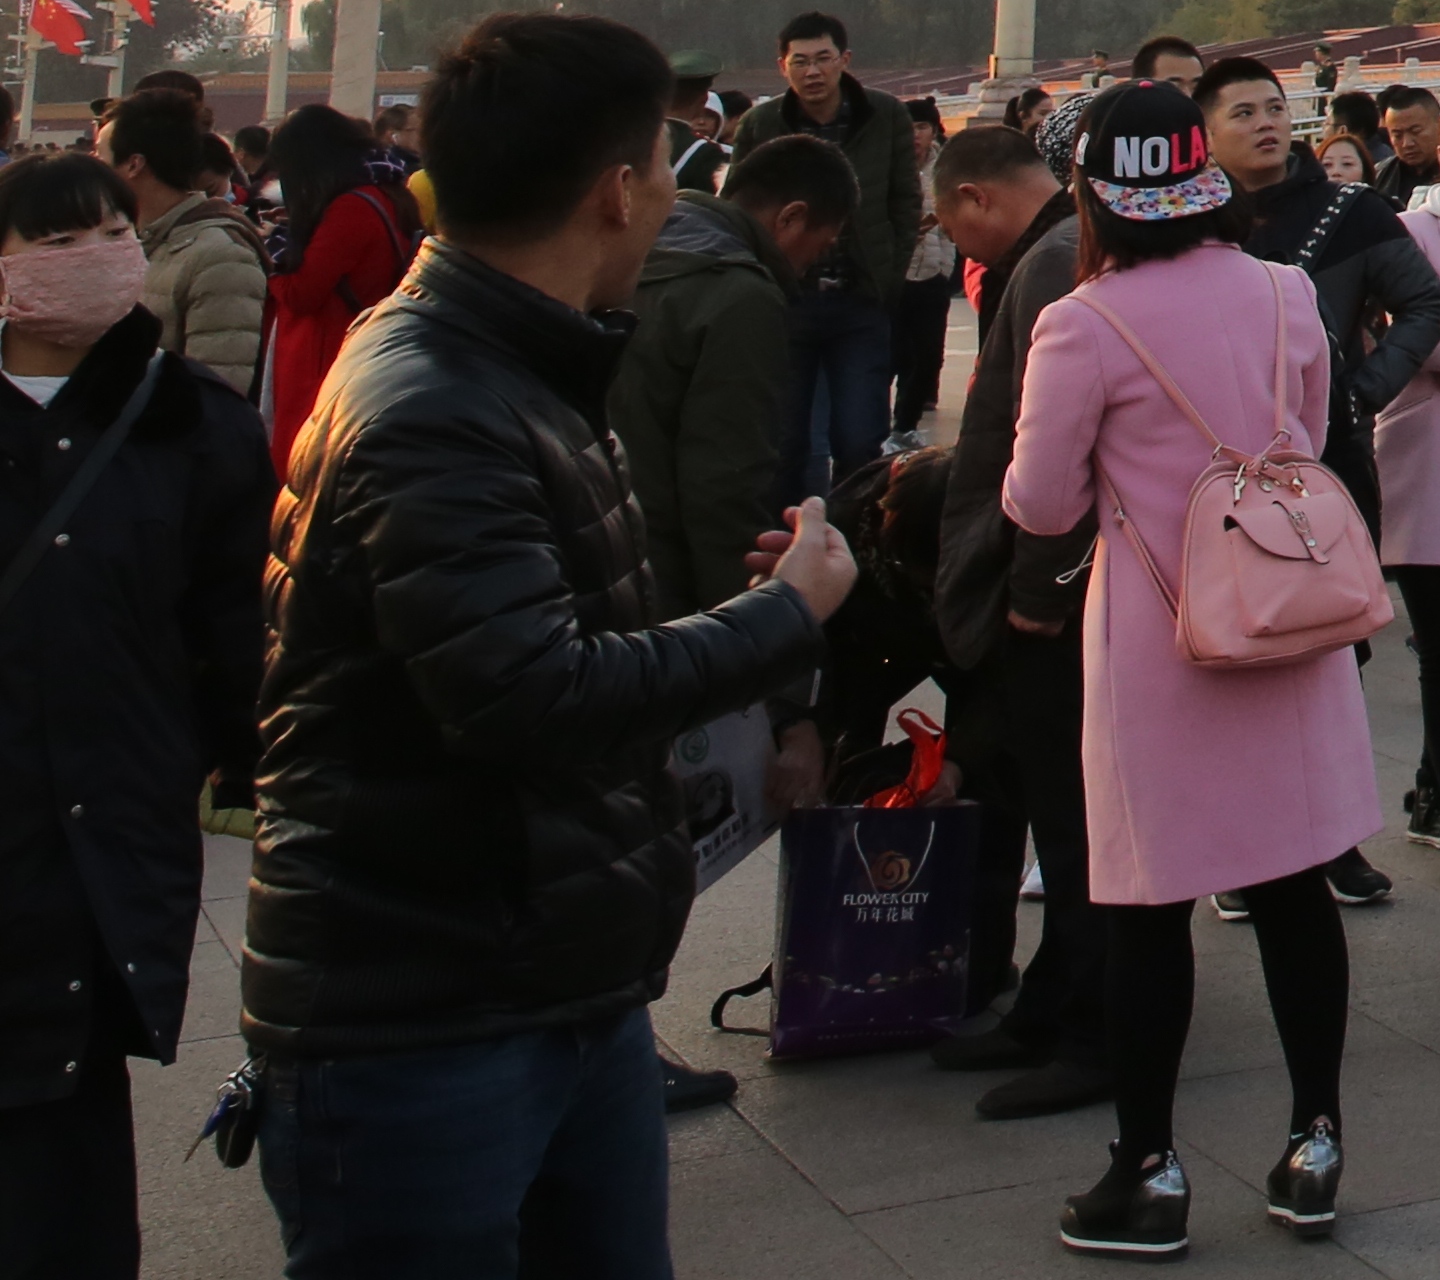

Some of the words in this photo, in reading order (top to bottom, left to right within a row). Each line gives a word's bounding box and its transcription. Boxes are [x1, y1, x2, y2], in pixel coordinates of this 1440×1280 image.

[1114, 125, 1206, 178] NOLA
[843, 893, 898, 905] FLOWER
[902, 892, 929, 904] CITY
[856, 907, 914, 923] 万年花城
